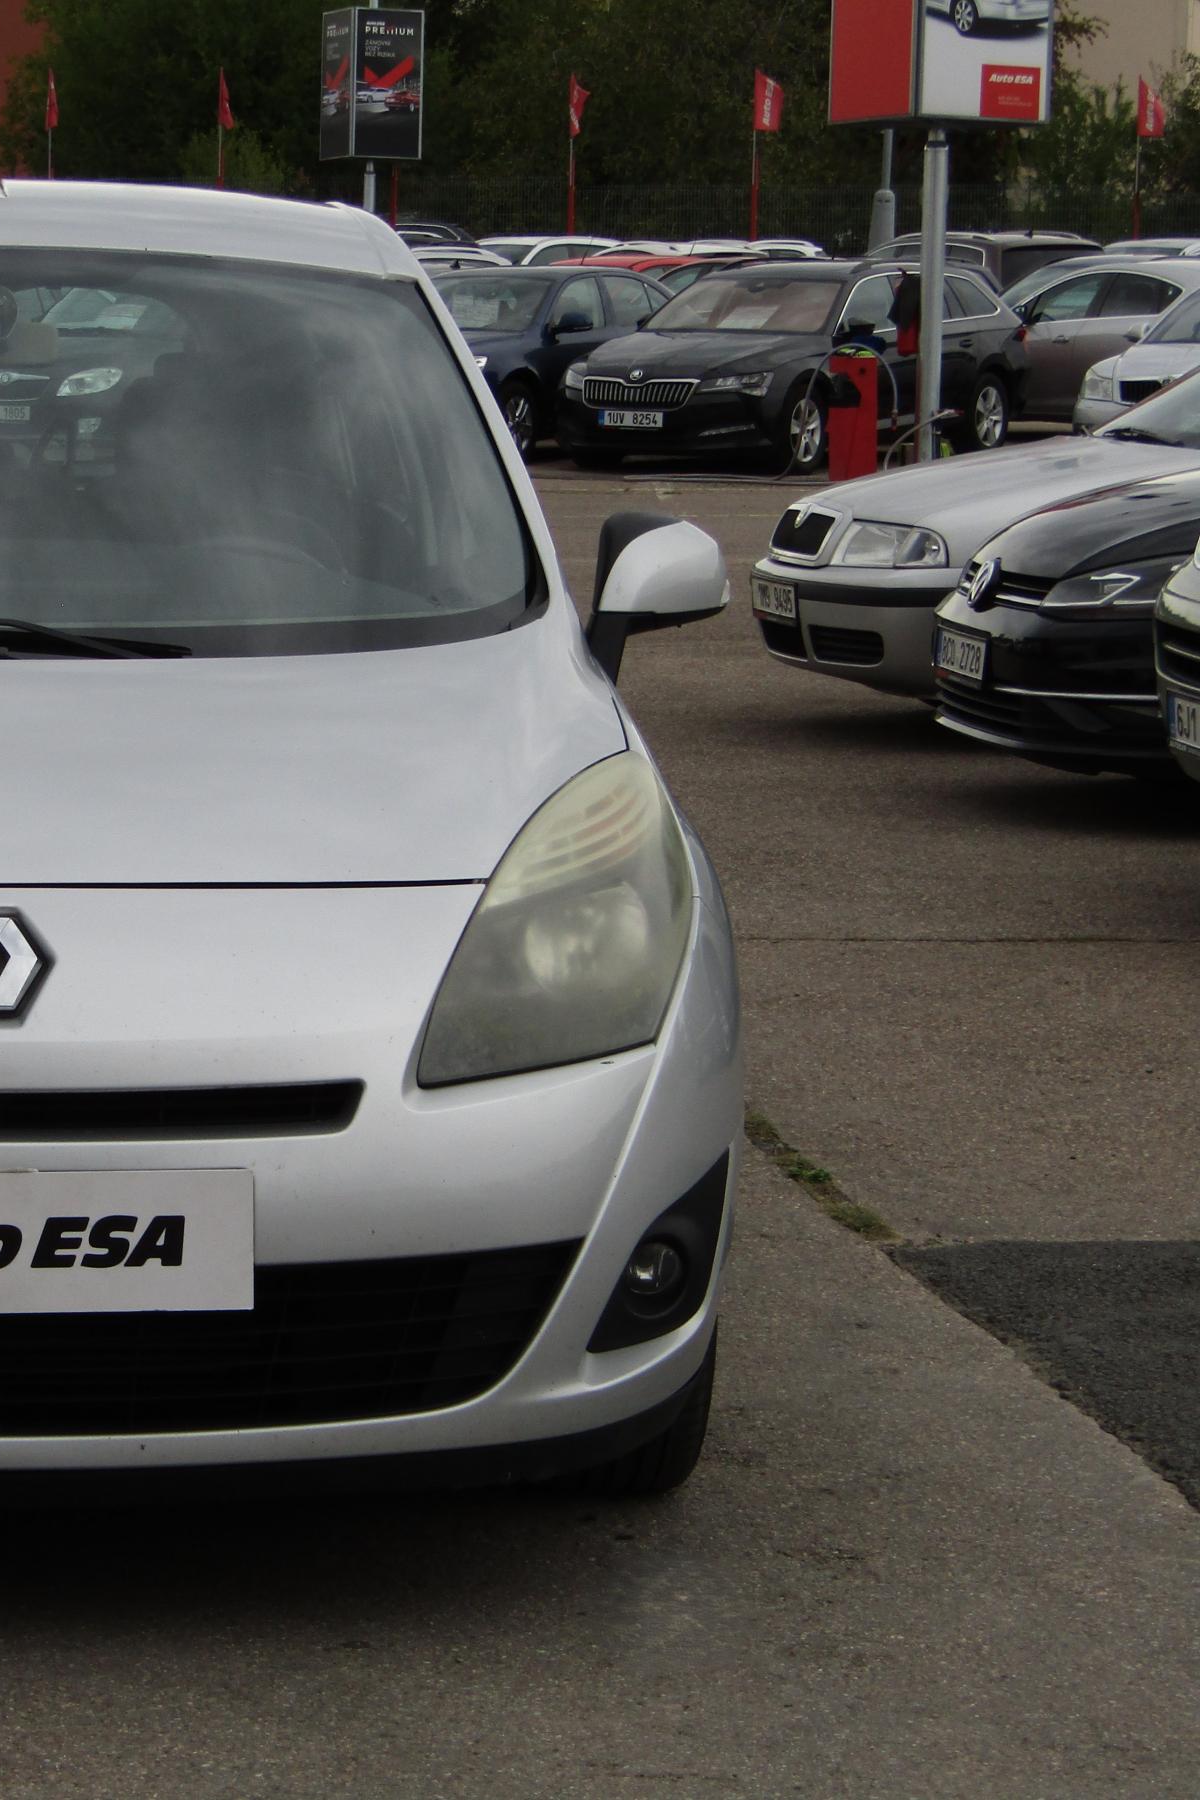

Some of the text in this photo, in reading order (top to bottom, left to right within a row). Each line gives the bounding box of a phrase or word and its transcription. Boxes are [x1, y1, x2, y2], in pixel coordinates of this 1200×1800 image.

[989, 74, 1033, 84] Auto ESA
[607, 413, 658, 425] 1UV 8254
[960, 641, 981, 674] 2728
[30, 1215, 185, 1269] ESA
